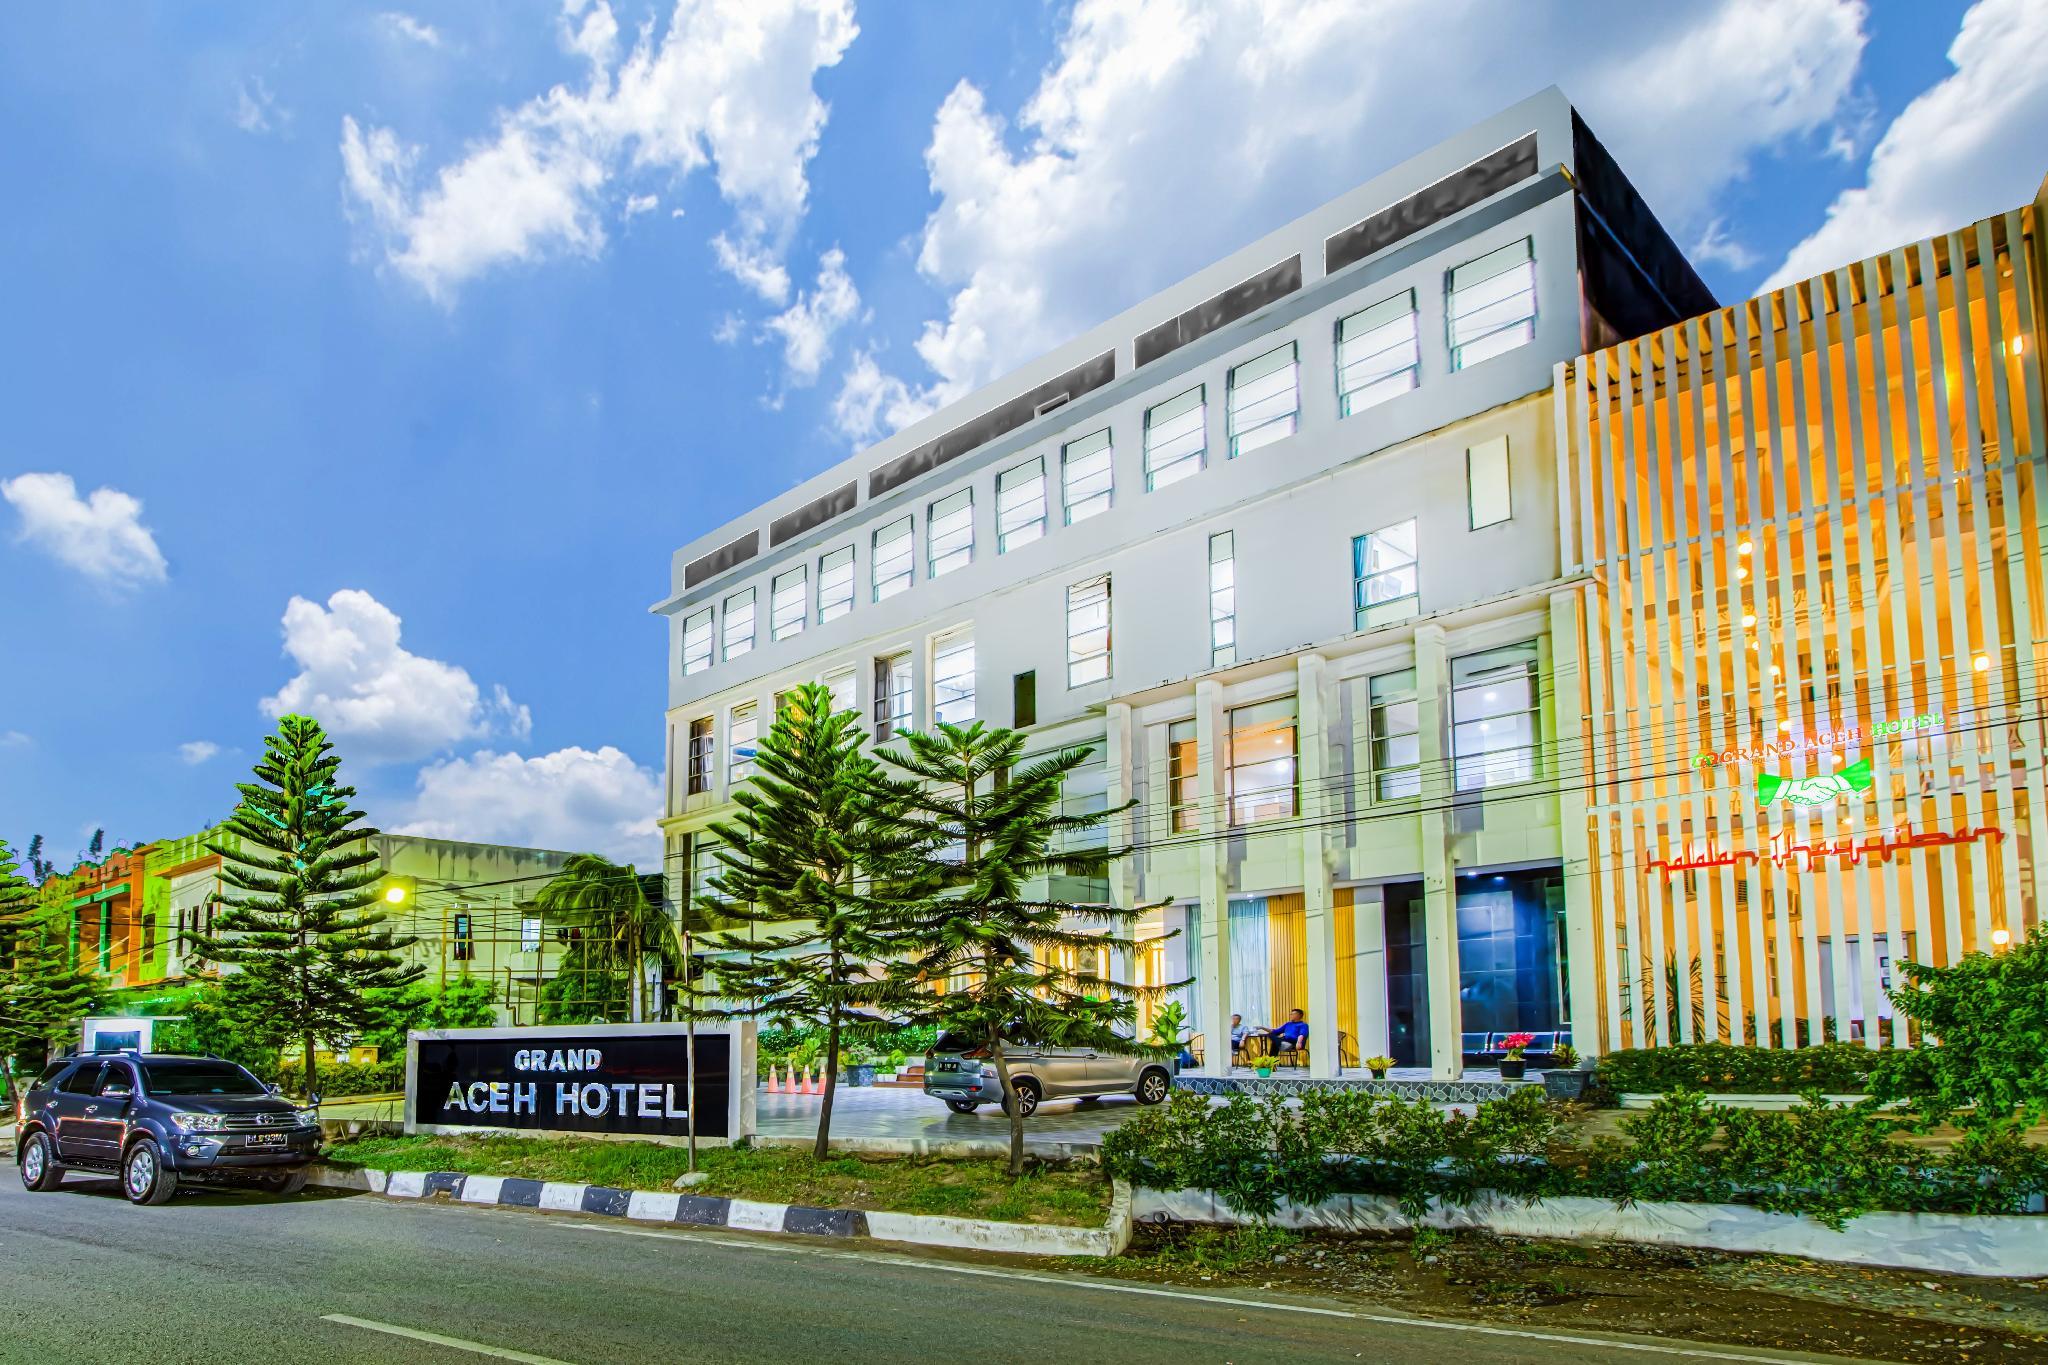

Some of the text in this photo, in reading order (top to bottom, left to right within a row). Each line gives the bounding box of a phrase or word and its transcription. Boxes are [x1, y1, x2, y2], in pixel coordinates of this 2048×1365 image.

[1720, 711, 1946, 764] GRAND ACEH HOTEL
[514, 1048, 602, 1073] GRAND
[444, 1081, 689, 1119] ACEH HOTEL
